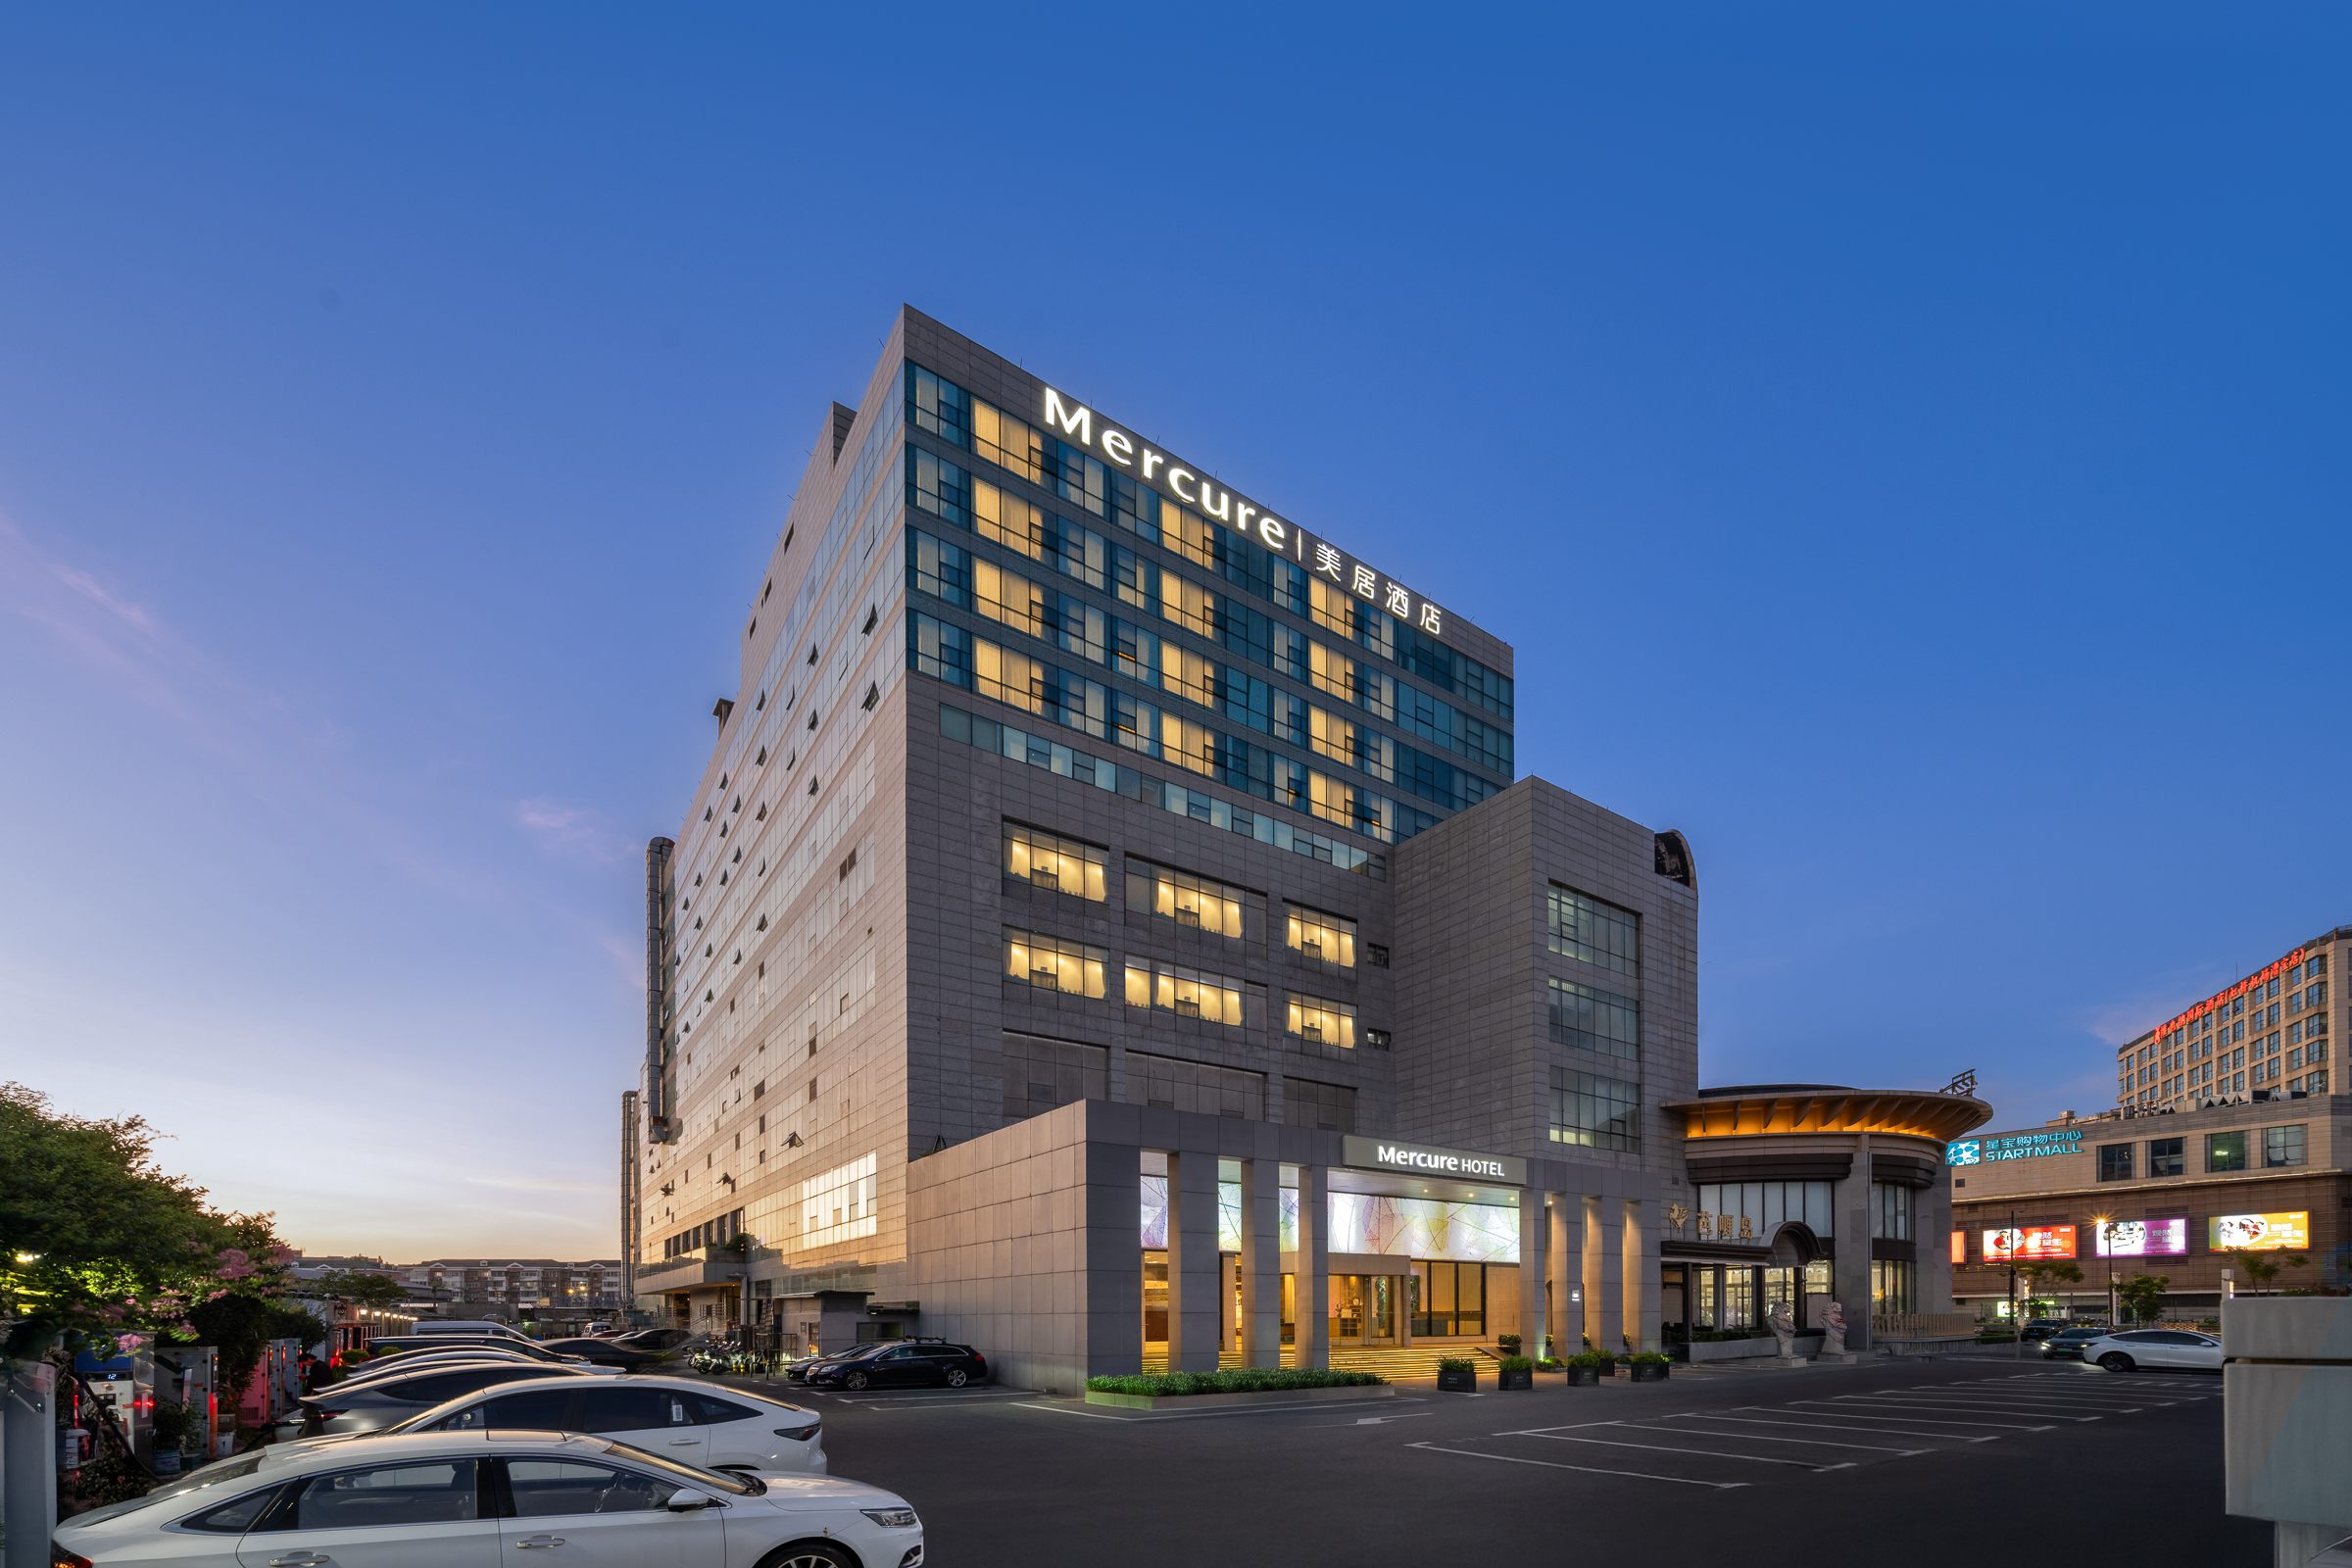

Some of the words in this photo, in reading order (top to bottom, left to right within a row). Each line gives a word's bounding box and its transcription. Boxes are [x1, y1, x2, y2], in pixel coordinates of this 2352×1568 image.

[1044, 387, 1286, 551] Mercure
[1314, 543, 1443, 636] 美居酒店
[1985, 1130, 2082, 1151] 星宝购物中心
[1377, 1146, 1458, 1171] Mercure
[1461, 1158, 1505, 1177] HOTEL
[1696, 1210, 1754, 1240] 芭喱岛
